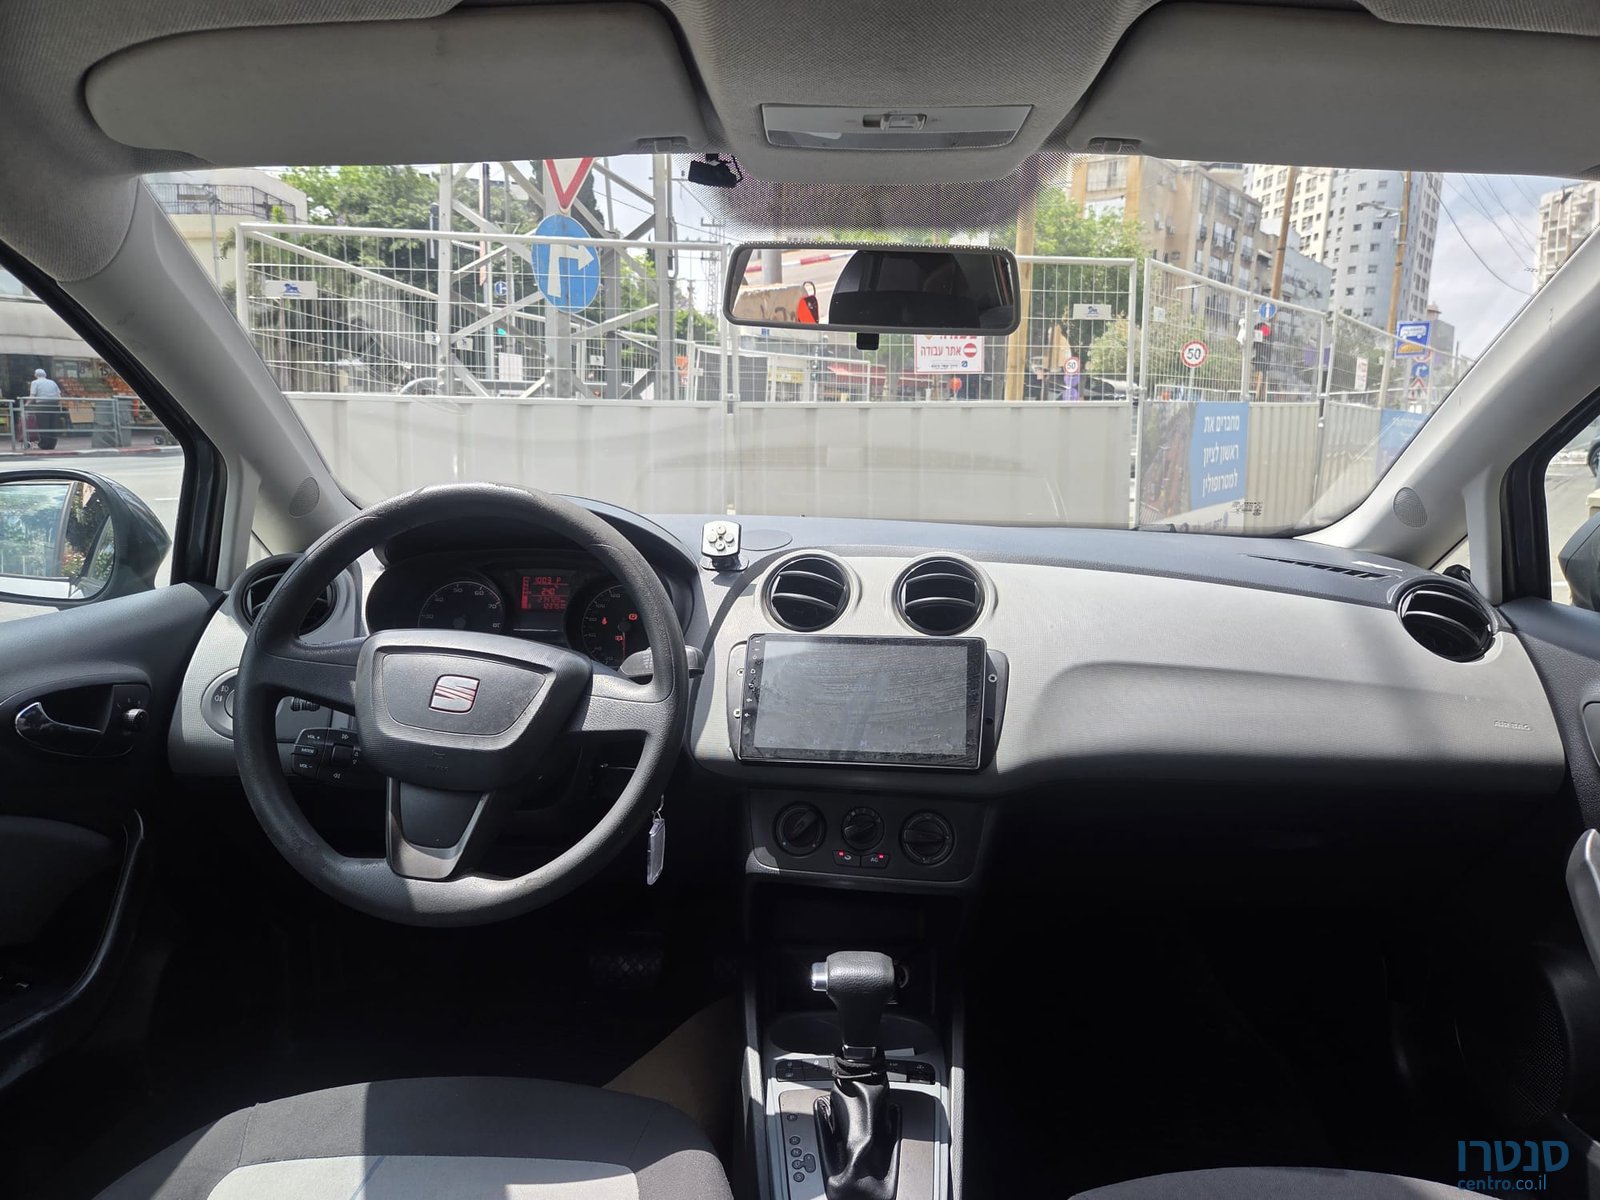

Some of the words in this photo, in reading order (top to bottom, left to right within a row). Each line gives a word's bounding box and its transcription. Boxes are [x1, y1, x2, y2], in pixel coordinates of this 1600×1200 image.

[920, 345, 943, 358] עבודה
[945, 345, 961, 357] אתר
[1186, 349, 1202, 360] 50
[1203, 415, 1215, 433] את
[1215, 415, 1241, 432] מחברים
[1203, 441, 1220, 469] לציון
[1219, 443, 1239, 465] ראשון
[1202, 466, 1238, 498] למטרופולין
